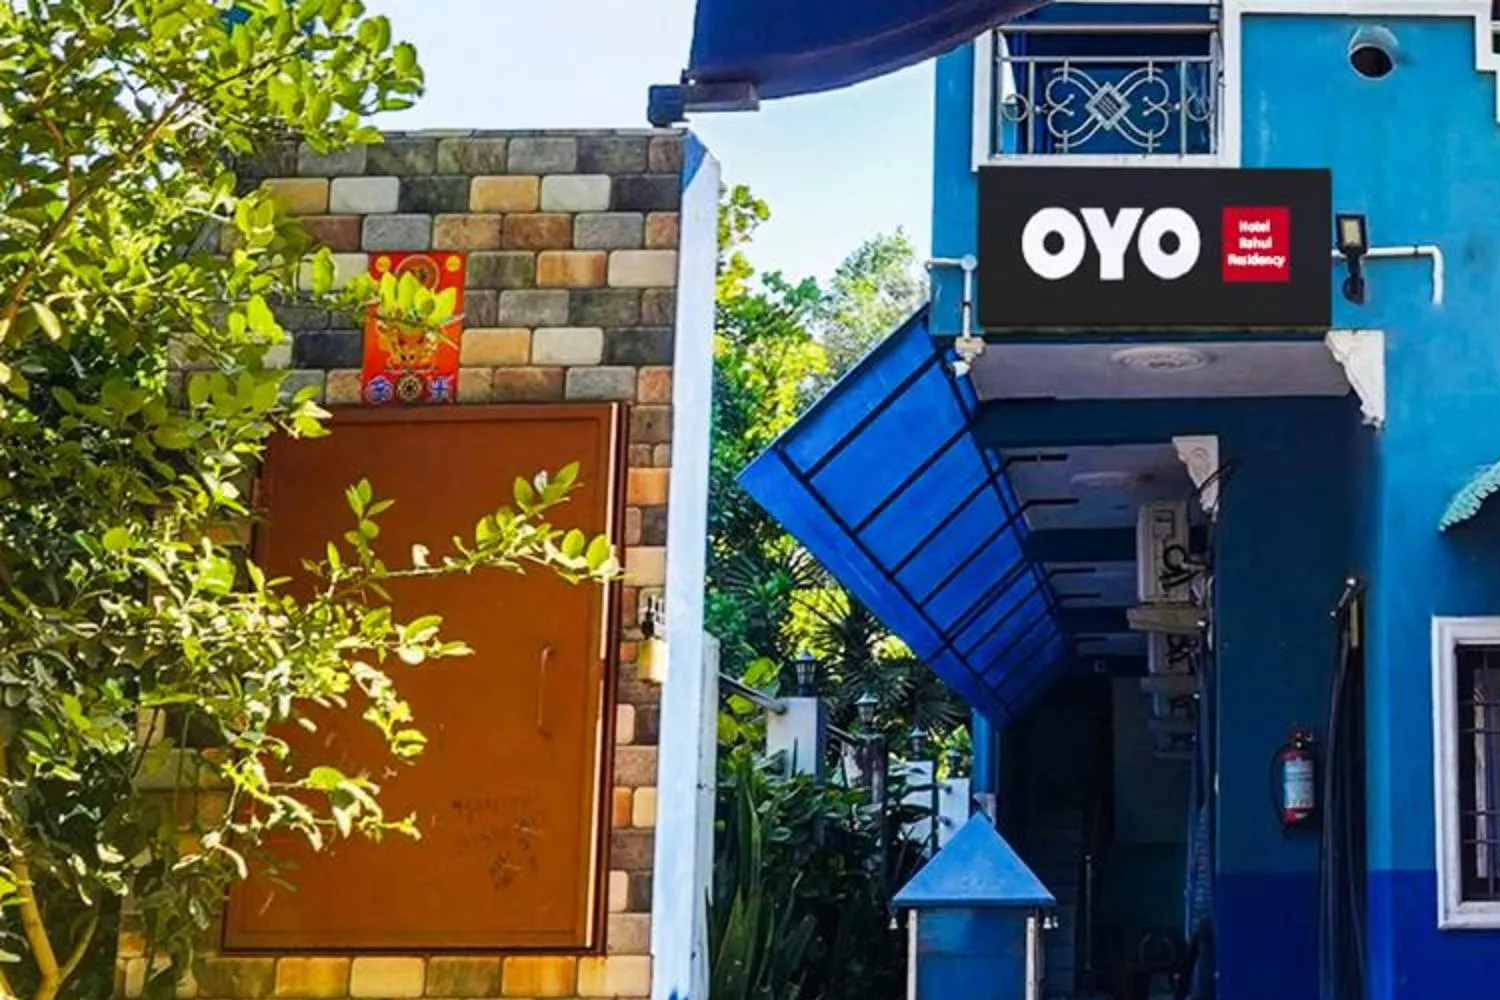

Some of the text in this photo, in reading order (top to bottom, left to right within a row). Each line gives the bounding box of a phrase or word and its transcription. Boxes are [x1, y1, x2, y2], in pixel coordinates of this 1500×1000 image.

[1239, 219, 1271, 233] Hotel
[1022, 207, 1201, 281] OYO
[1239, 236, 1273, 249] Rahul
[1228, 253, 1286, 269] Residency
